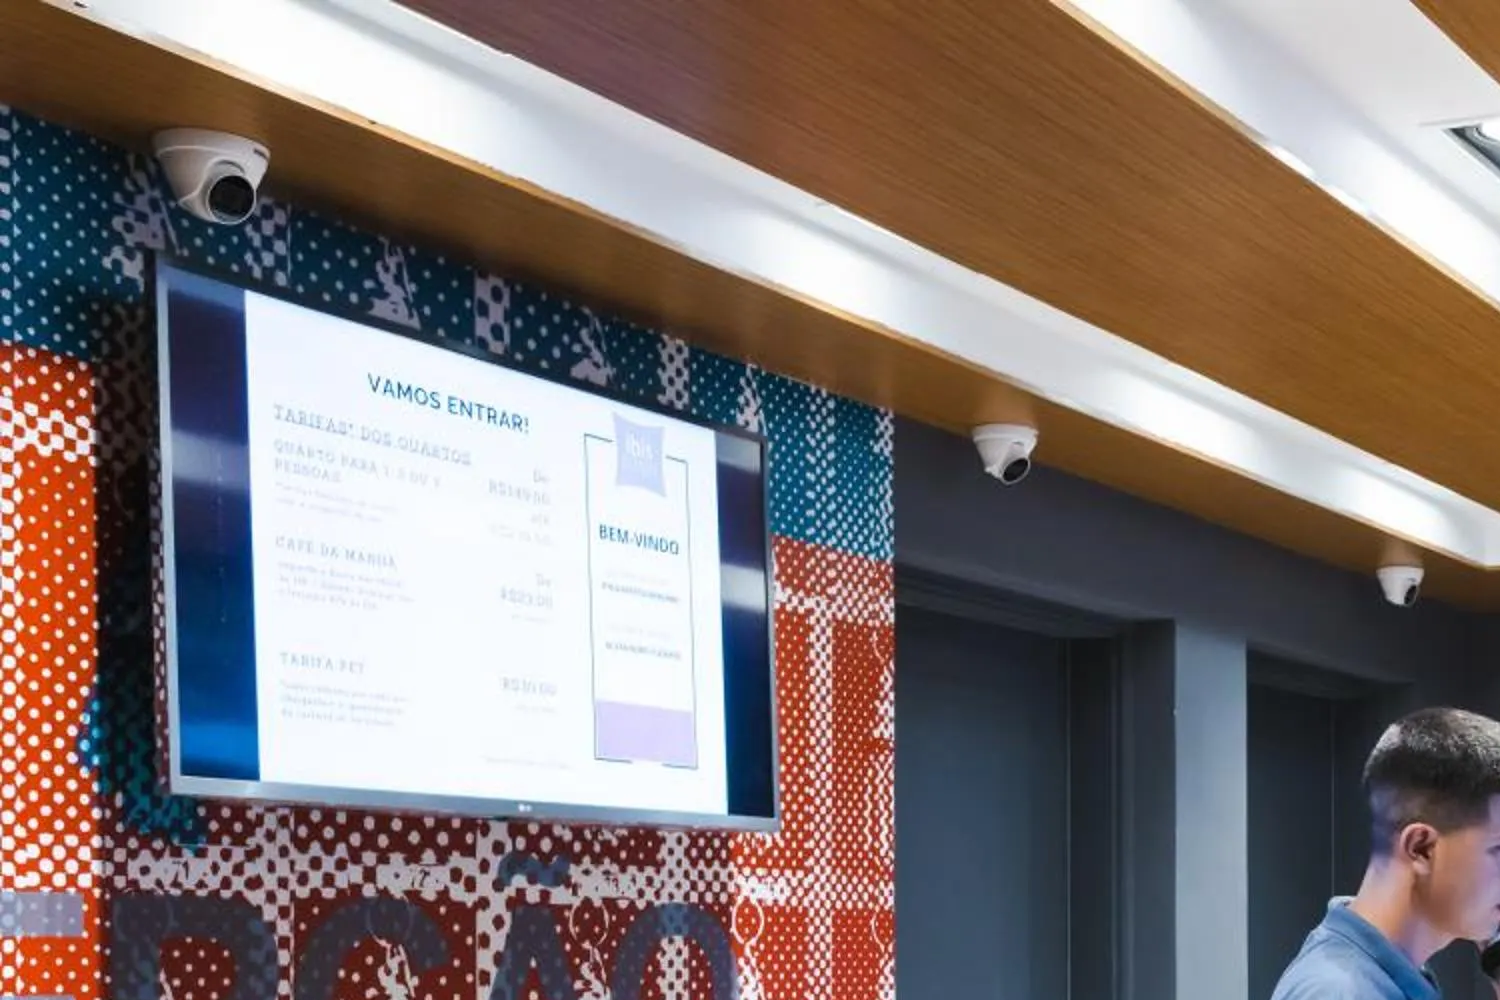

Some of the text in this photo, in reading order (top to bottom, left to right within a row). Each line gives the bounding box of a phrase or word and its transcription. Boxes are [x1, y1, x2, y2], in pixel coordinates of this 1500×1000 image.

[367, 373, 530, 434] VAMOS ENTRAR!
[598, 523, 680, 556] BEM-VINDO
